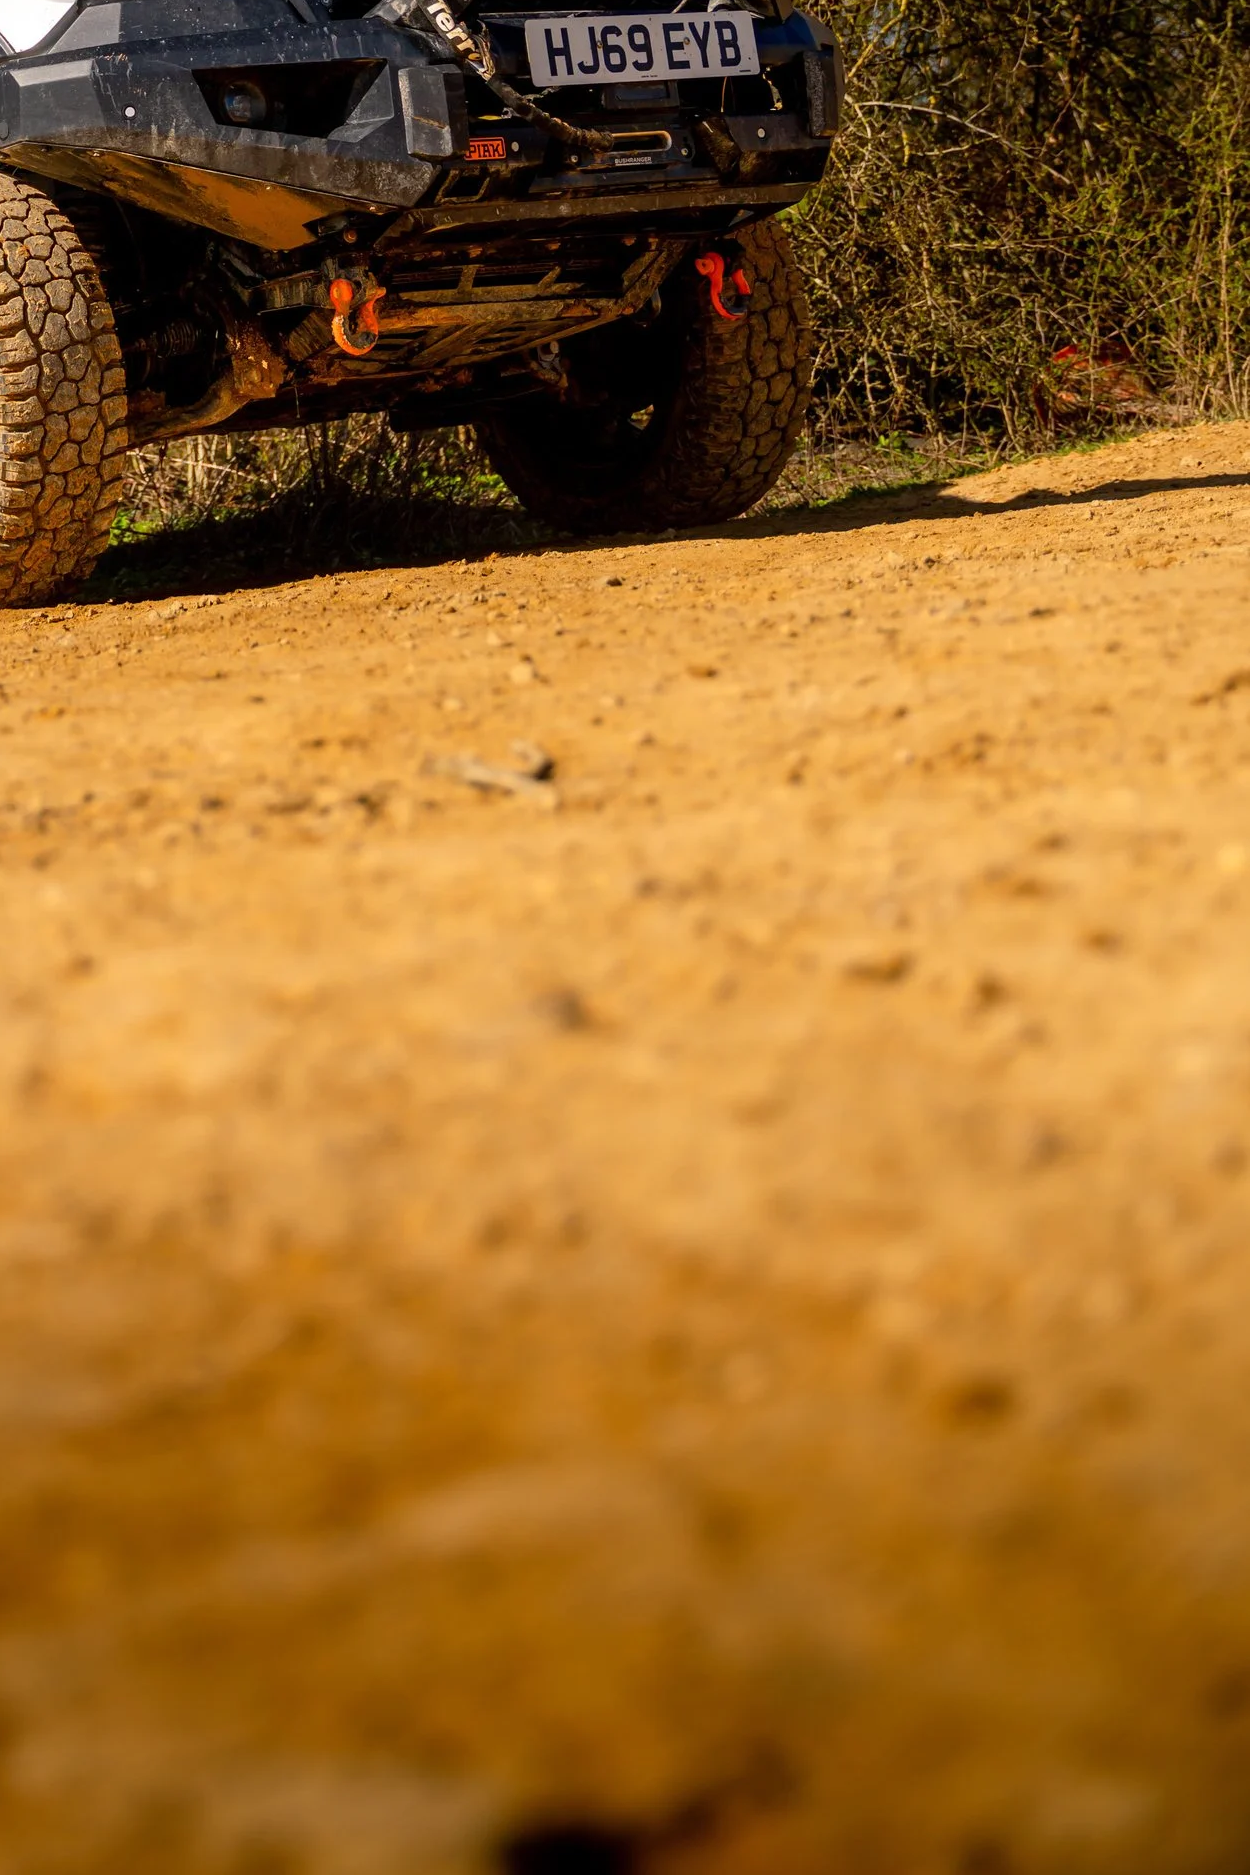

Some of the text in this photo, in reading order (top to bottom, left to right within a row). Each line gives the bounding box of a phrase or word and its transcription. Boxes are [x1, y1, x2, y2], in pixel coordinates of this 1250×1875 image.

[544, 20, 742, 77] HJ69 EYB
[614, 156, 652, 165] BUSHRANGER
